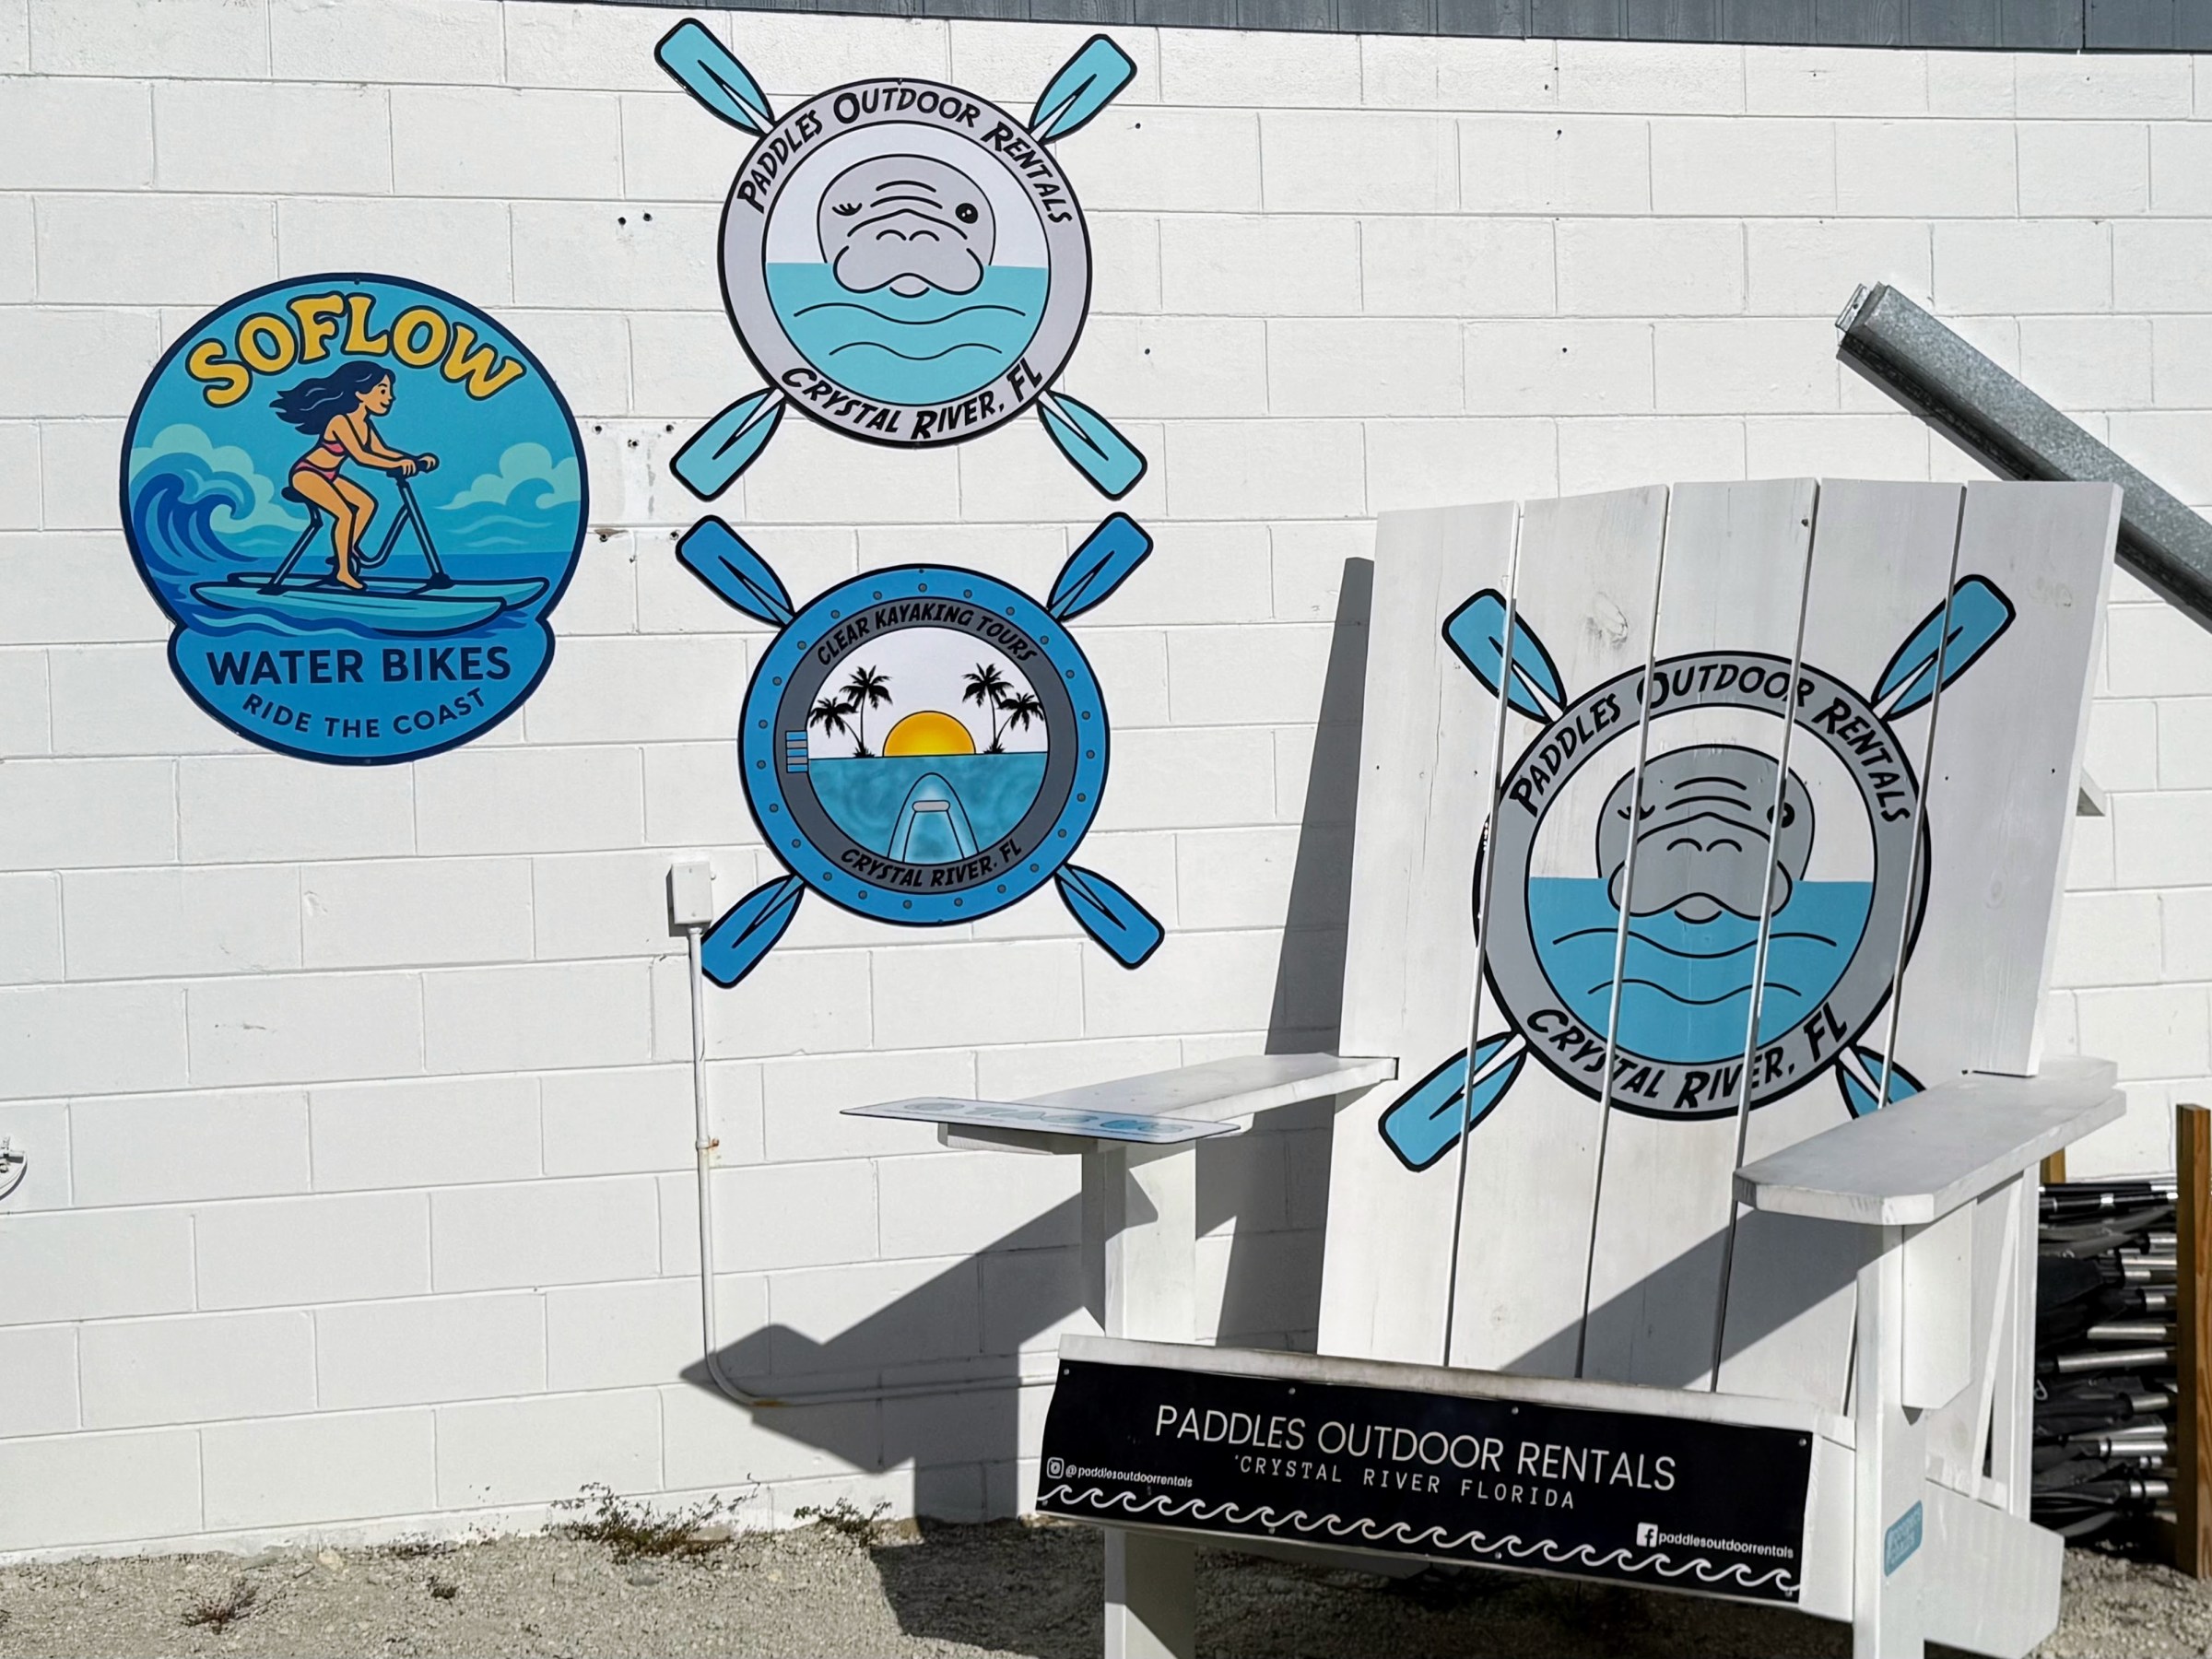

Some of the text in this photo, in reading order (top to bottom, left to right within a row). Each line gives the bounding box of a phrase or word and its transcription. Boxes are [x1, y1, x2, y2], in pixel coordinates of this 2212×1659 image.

[737, 88, 1073, 224] PADDLES OUTDOOR RENTALS
[187, 291, 526, 407] SOFLOW
[782, 358, 1042, 440] CRYSTAL RIVER, FL
[206, 646, 512, 686] WATER BIKES
[818, 603, 1038, 666] CLEAR KAYAKING TOURS
[242, 688, 486, 738] RIDE THE COAST
[1509, 664, 1911, 823] PADDLES OUTDOOR RENTALS
[841, 848, 924, 888] CRYSTAL
[1003, 837, 1022, 863] FL
[1527, 1009, 1666, 1099] CRYSTAL
[1804, 1002, 1847, 1063] FL
[1065, 1465, 1193, 1488] @paddlesoutdoorrentals
[1156, 1405, 1677, 1491] PADDLES OUTDOOR RENTALS
[1363, 1467, 1440, 1494] RIVER
[1461, 1478, 1574, 1510] FLORIDA
[1659, 1533, 1794, 1559] paddlesoutdoorrentals
